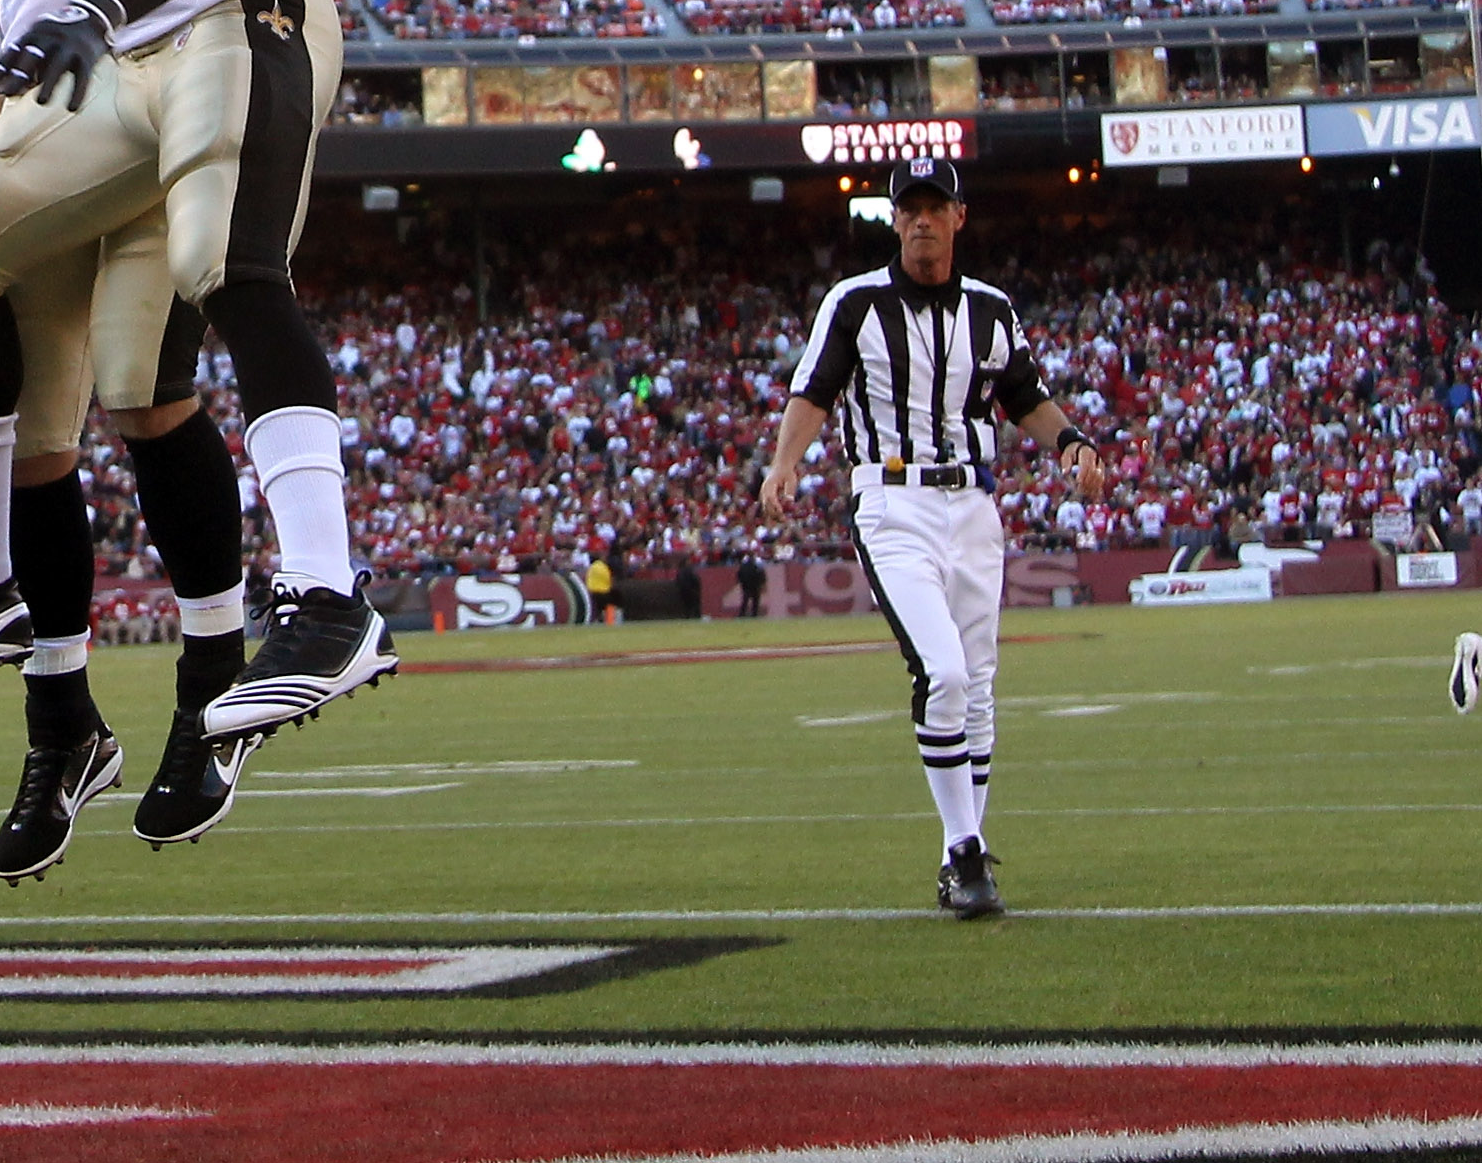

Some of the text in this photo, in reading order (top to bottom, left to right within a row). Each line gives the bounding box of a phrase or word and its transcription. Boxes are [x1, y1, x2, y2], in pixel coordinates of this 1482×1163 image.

[833, 121, 963, 146] STANFORD
[1147, 111, 1295, 138] STANFORD
[1356, 100, 1475, 147] VISA
[1148, 138, 1295, 156] MEDICINE
